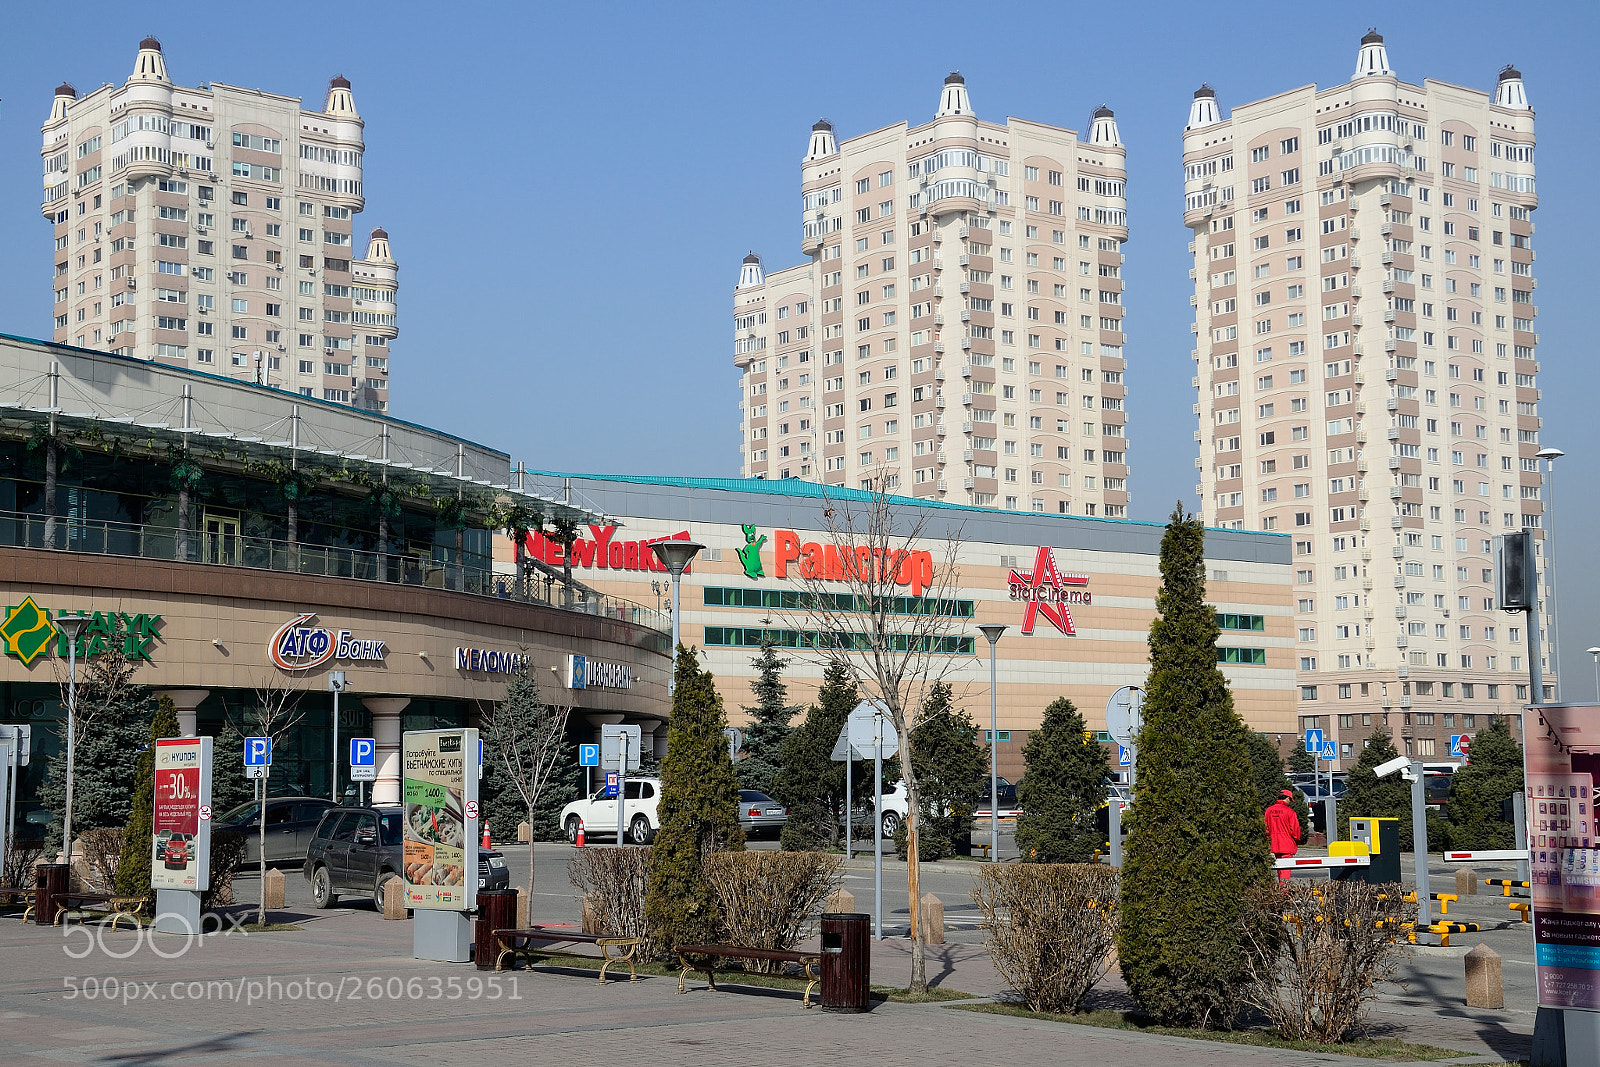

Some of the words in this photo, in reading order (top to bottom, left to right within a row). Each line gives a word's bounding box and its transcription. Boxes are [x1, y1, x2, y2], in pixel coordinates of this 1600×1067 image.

[280, 626, 330, 659] АТФ
[335, 630, 385, 660] Банк
[252, 740, 267, 763] P
[357, 741, 371, 764] P
[585, 746, 596, 764] P
